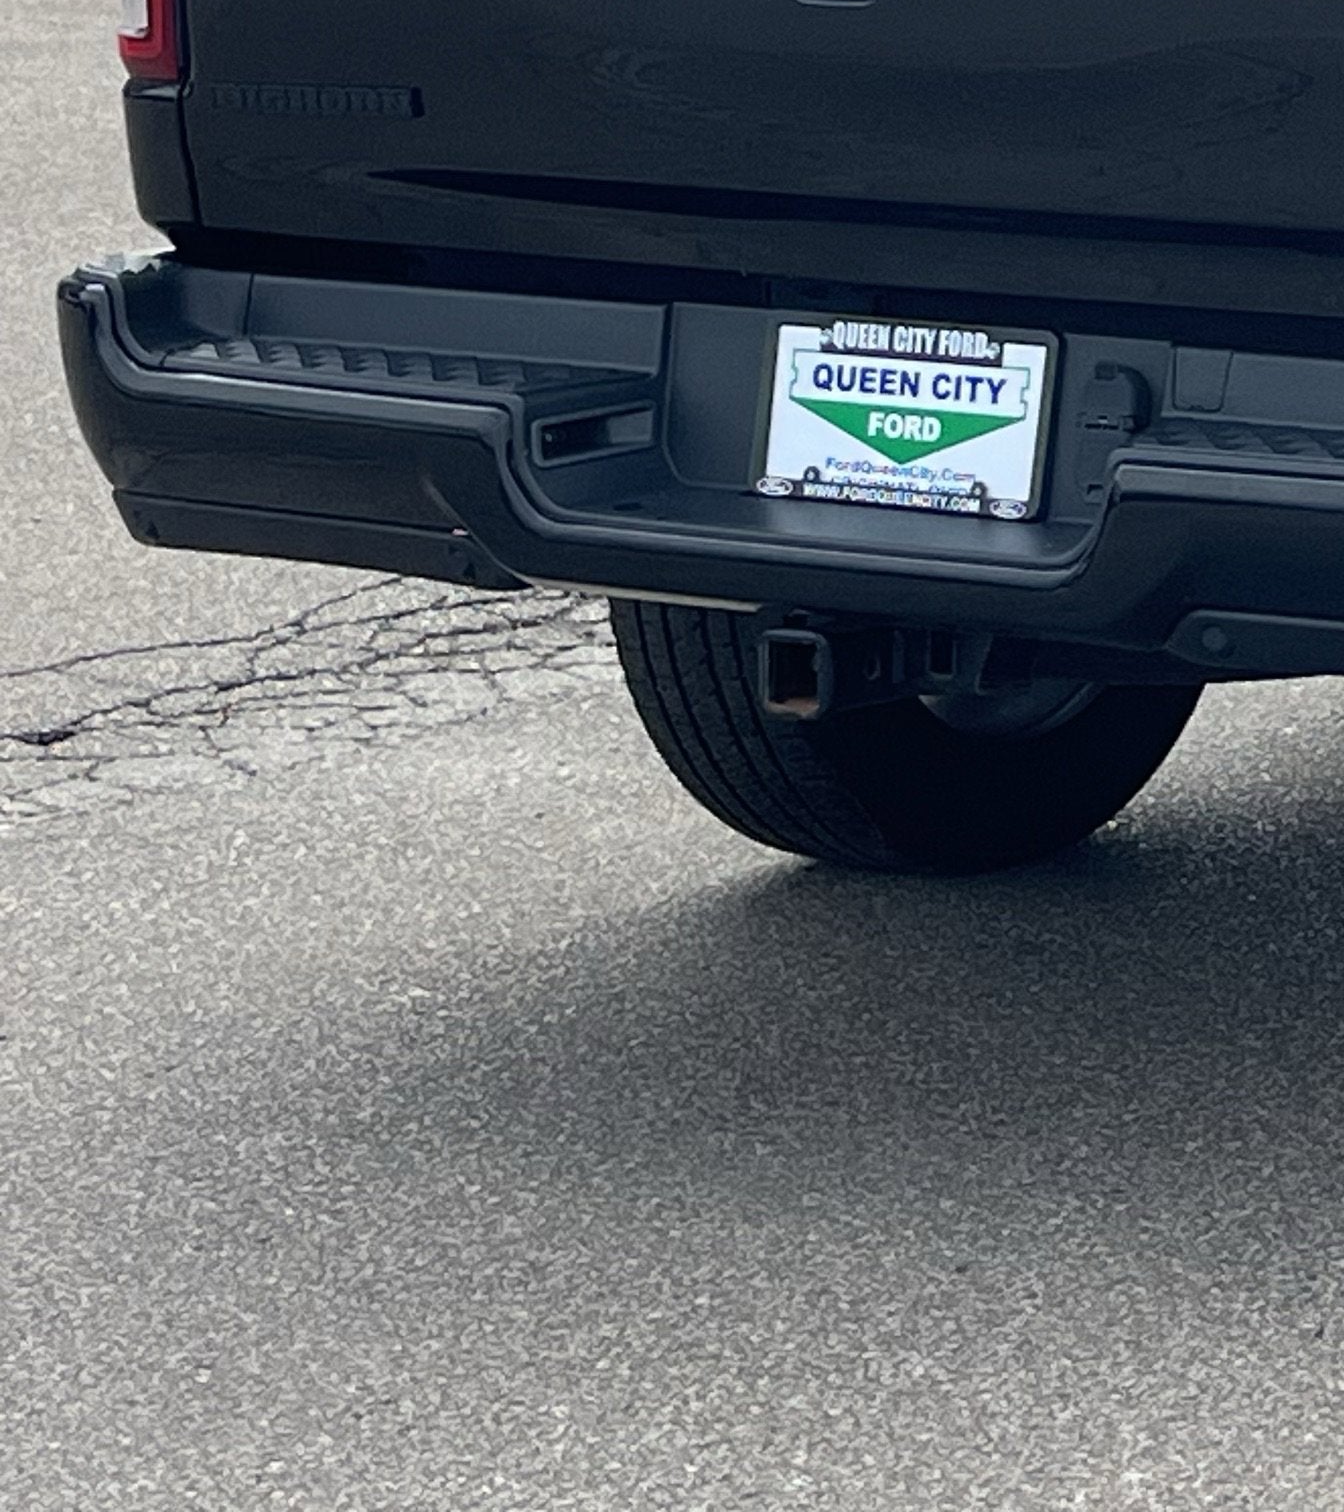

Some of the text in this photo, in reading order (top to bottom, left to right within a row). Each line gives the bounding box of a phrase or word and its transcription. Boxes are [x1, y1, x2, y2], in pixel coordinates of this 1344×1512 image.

[832, 320, 990, 360] QUEEN CITY FORD
[812, 362, 1008, 405] QUEEN CITY
[866, 410, 943, 443] FORD
